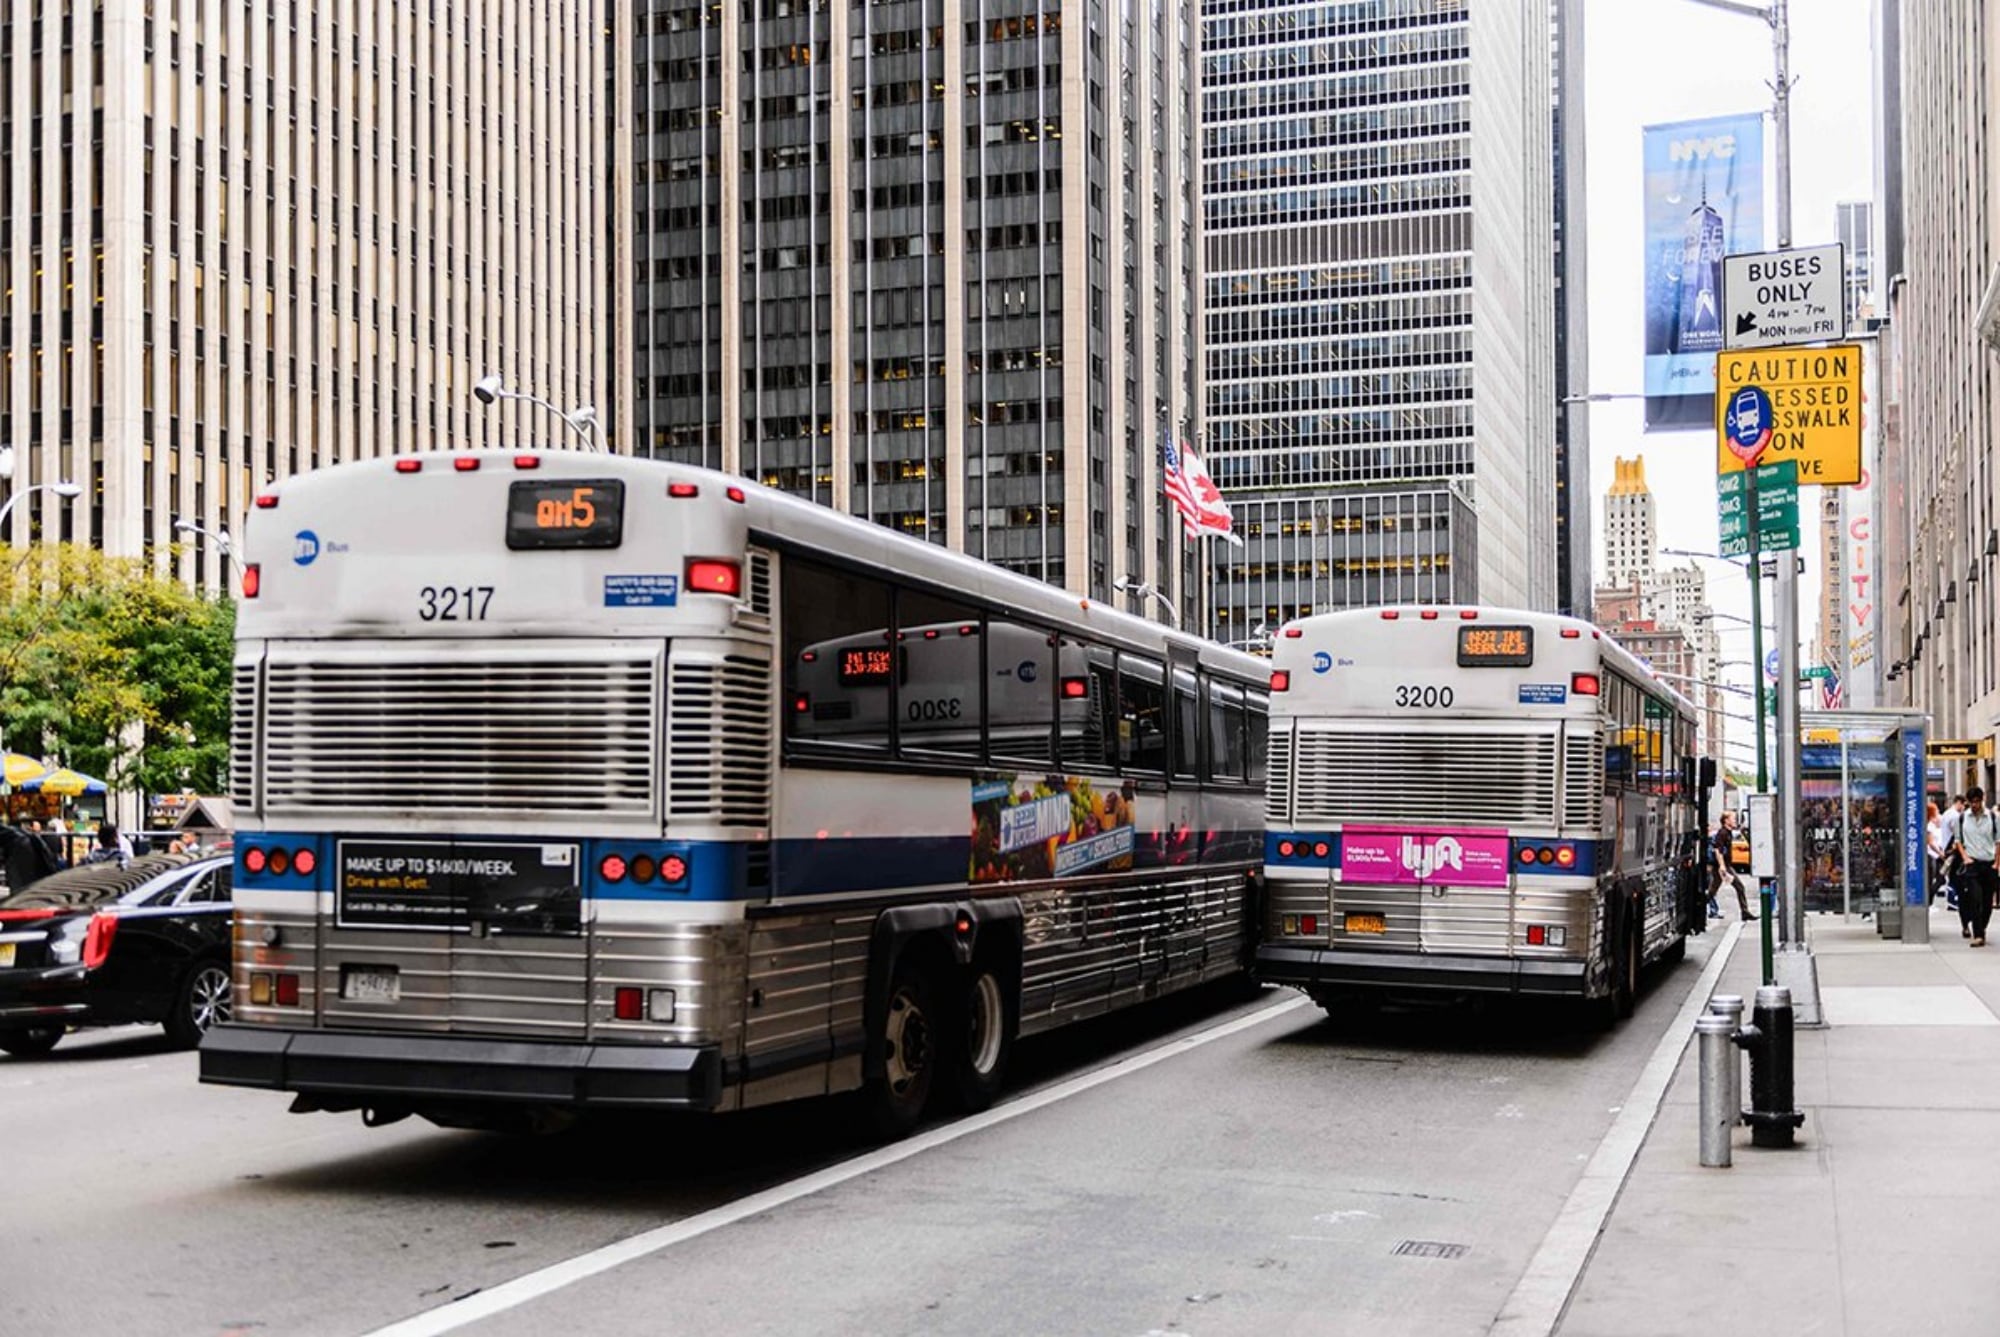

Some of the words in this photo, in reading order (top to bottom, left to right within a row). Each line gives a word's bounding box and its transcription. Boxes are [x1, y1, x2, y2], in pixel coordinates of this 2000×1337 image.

[1669, 135, 1736, 161] NYC
[1748, 255, 1822, 282] BUSES
[1757, 281, 1813, 305] ONLY
[1767, 308, 1790, 319] 4PM
[1804, 303, 1826, 316] 7PM
[1699, 330, 1722, 338] WORL
[1759, 325, 1786, 338] MON
[1788, 326, 1811, 335] THRU
[1813, 319, 1835, 333] FRI
[1729, 355, 1848, 383] CAUTION
[1774, 385, 1849, 408] ESSED
[1772, 408, 1850, 429] SSWALK
[1772, 432, 1805, 451] ON
[1800, 459, 1824, 475] VE
[326, 540, 349, 553] Bus
[1850, 517, 1873, 627] CITY
[419, 586, 495, 621] 3217
[1395, 685, 1454, 708] 3200
[1906, 752, 1917, 788] Avenue
[1036, 793, 1072, 843] MIND
[1907, 799, 1918, 825] West
[1805, 828, 1836, 839] ANY
[346, 857, 384, 871] MAKE
[385, 858, 405, 872] UP
[407, 858, 425, 873] TO
[1402, 835, 1464, 879] lyft
[1907, 841, 1918, 872] Street
[346, 874, 375, 888] Drive
[377, 876, 400, 889] with
